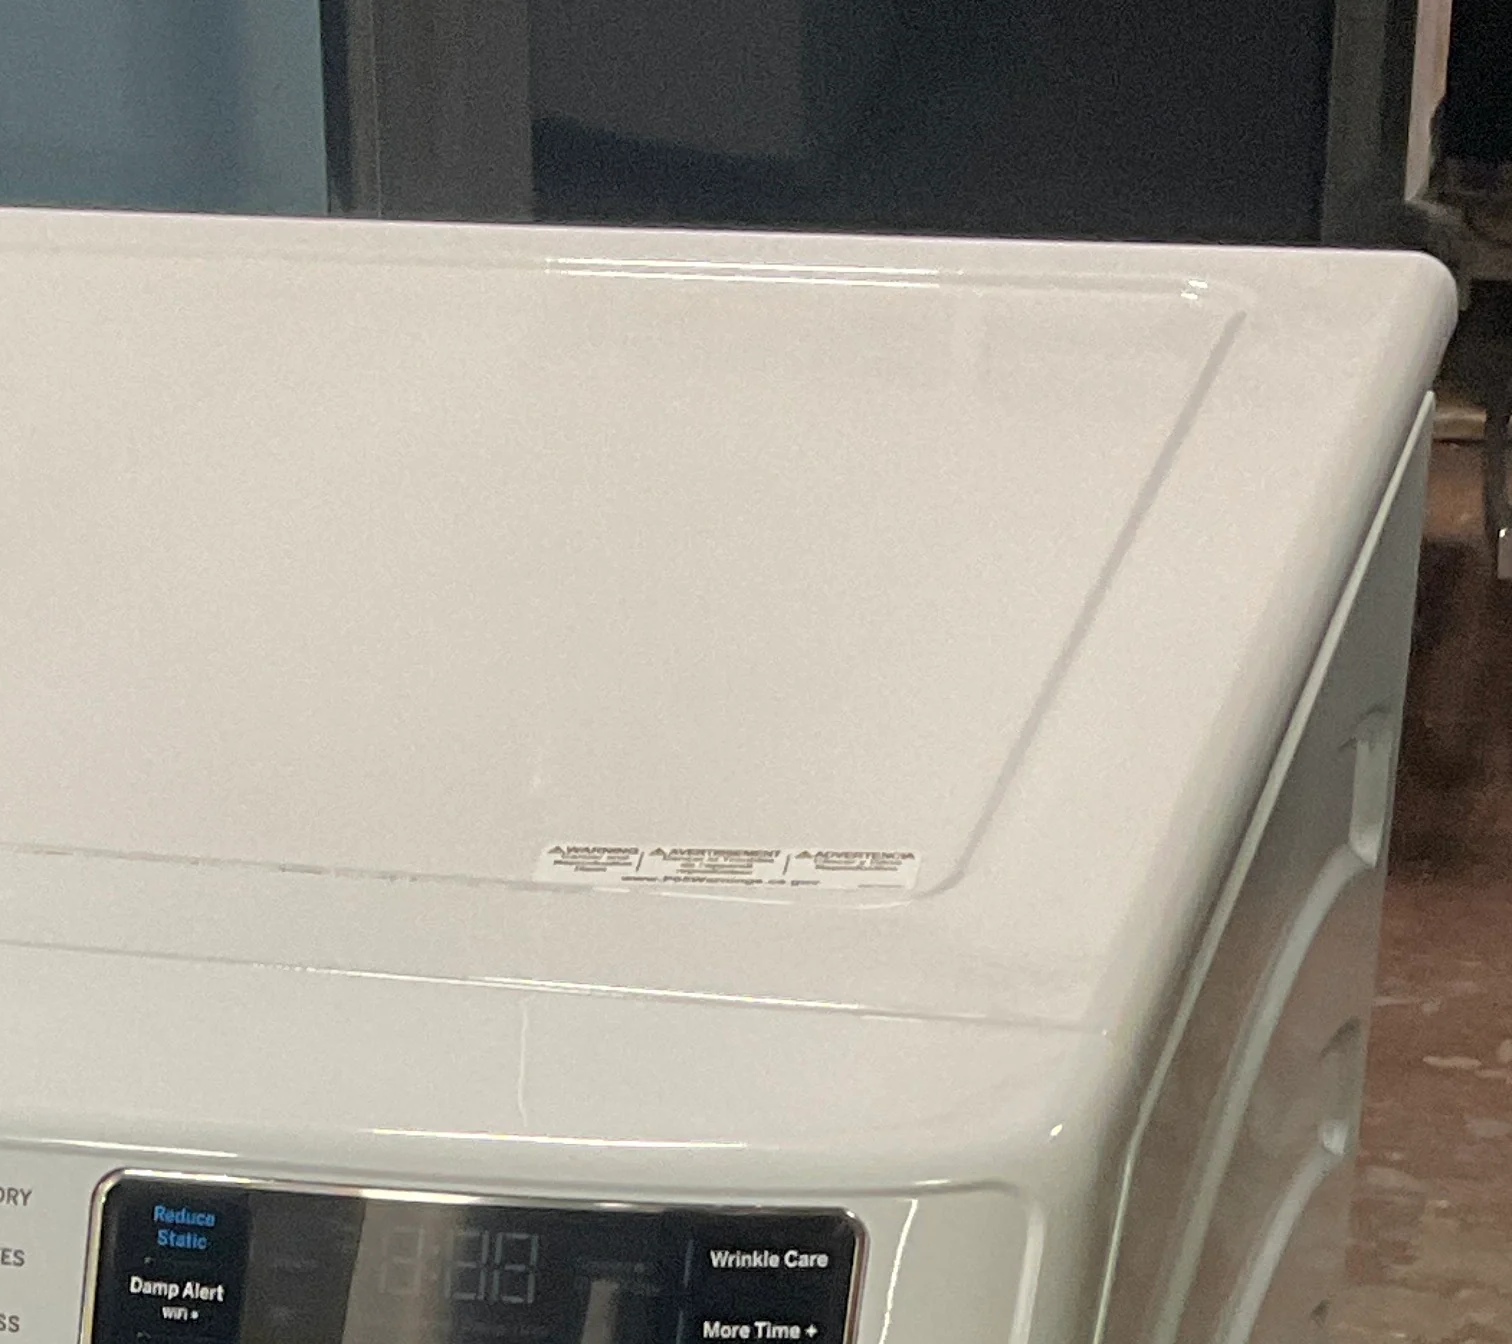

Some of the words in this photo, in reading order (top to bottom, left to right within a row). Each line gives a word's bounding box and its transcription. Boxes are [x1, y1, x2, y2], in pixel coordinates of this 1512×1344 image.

[153, 1205, 216, 1227] Reduce
[157, 1228, 209, 1250] Static
[710, 1250, 780, 1269] Wrinkle
[783, 1250, 829, 1269] Care
[129, 1275, 180, 1300] Damp
[182, 1281, 226, 1302] Alert
[702, 1320, 751, 1339] More
[754, 1320, 801, 1339] Time
